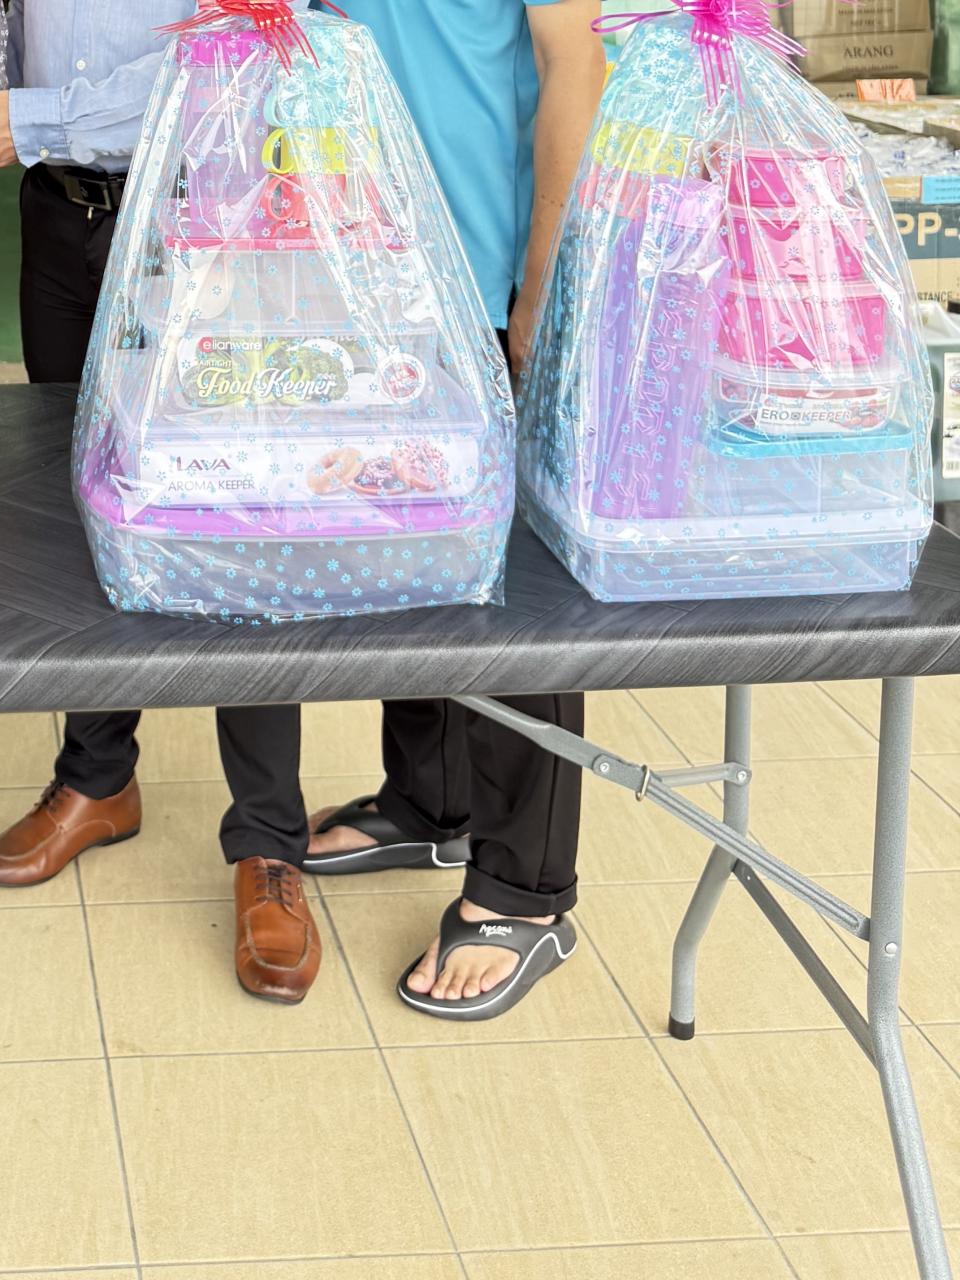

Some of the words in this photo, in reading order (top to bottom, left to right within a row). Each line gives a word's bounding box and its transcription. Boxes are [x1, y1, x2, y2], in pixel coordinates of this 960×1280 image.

[843, 45, 894, 59] ARANG
[895, 211, 960, 247] PP-
[198, 336, 262, 353] elianware
[197, 366, 258, 398] Food
[255, 367, 337, 400] Keeper
[176, 455, 231, 472] LAVA
[167, 480, 216, 491] AROMA
[218, 479, 255, 490] KEEPER
